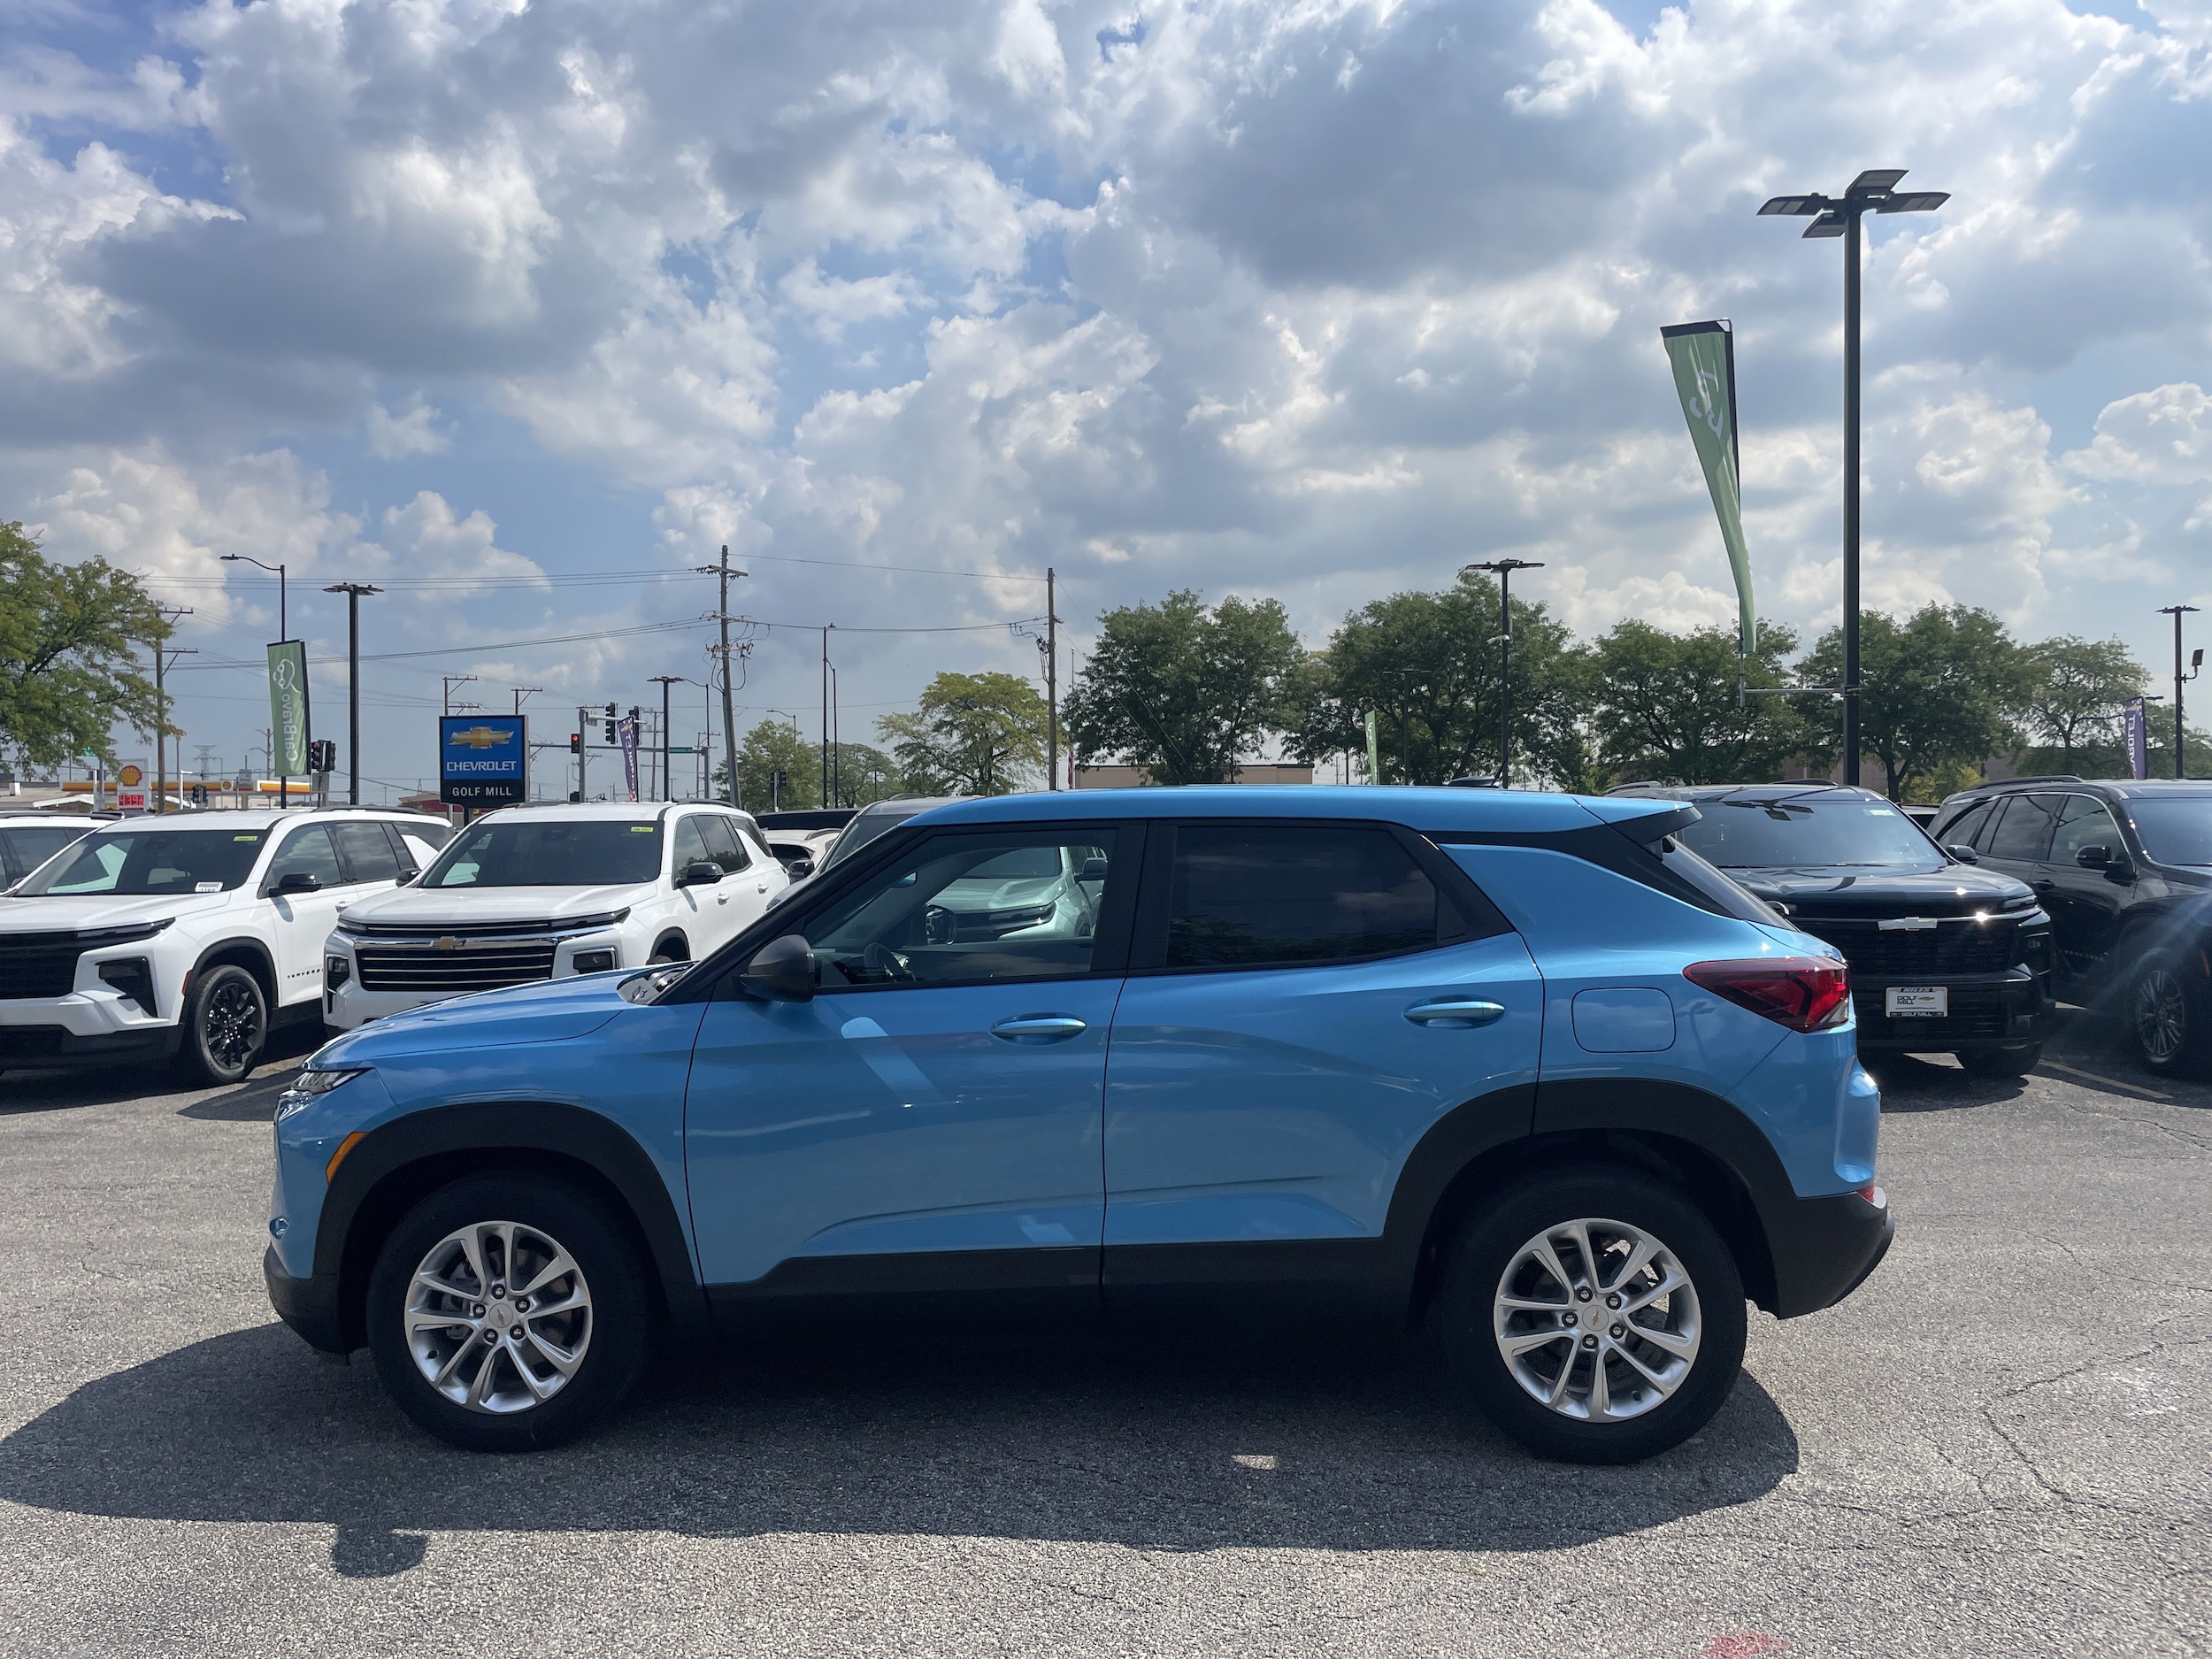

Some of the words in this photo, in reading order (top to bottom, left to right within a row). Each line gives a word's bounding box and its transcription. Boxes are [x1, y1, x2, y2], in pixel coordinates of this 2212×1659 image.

[446, 761, 518, 772] CHEVROLET
[452, 787, 481, 796] GOLF
[485, 787, 512, 796] MILL
